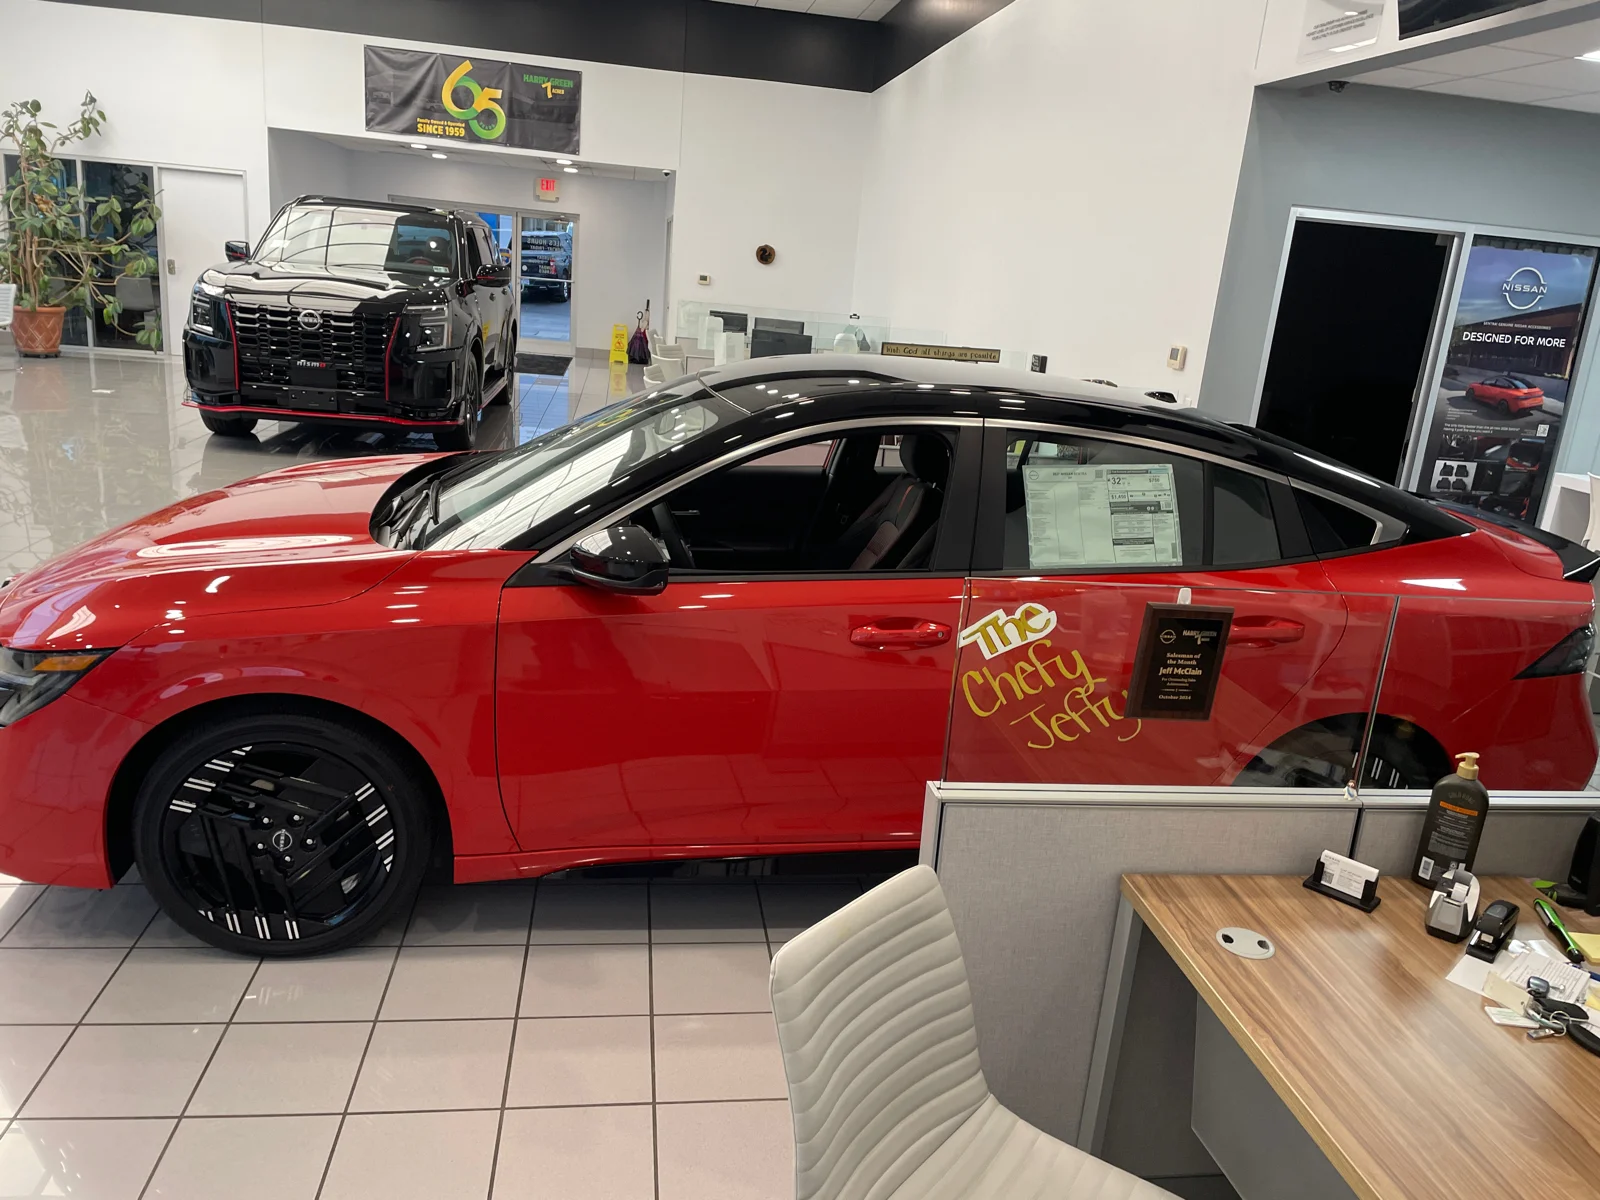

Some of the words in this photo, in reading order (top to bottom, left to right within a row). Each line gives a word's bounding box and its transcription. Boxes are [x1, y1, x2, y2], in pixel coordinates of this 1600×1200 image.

[442, 60, 506, 140] 65
[417, 123, 443, 135] SINCE
[445, 126, 465, 137] 1959
[540, 178, 556, 191] EXIT
[1502, 282, 1548, 294] NISSAN
[1462, 331, 1512, 344] DESIGNED
[1514, 334, 1535, 346] FOR
[1536, 336, 1566, 348] MORE
[903, 346, 918, 355] God
[962, 605, 1051, 656] The
[1158, 666, 1173, 676] Jeff
[1173, 667, 1202, 676] McClain
